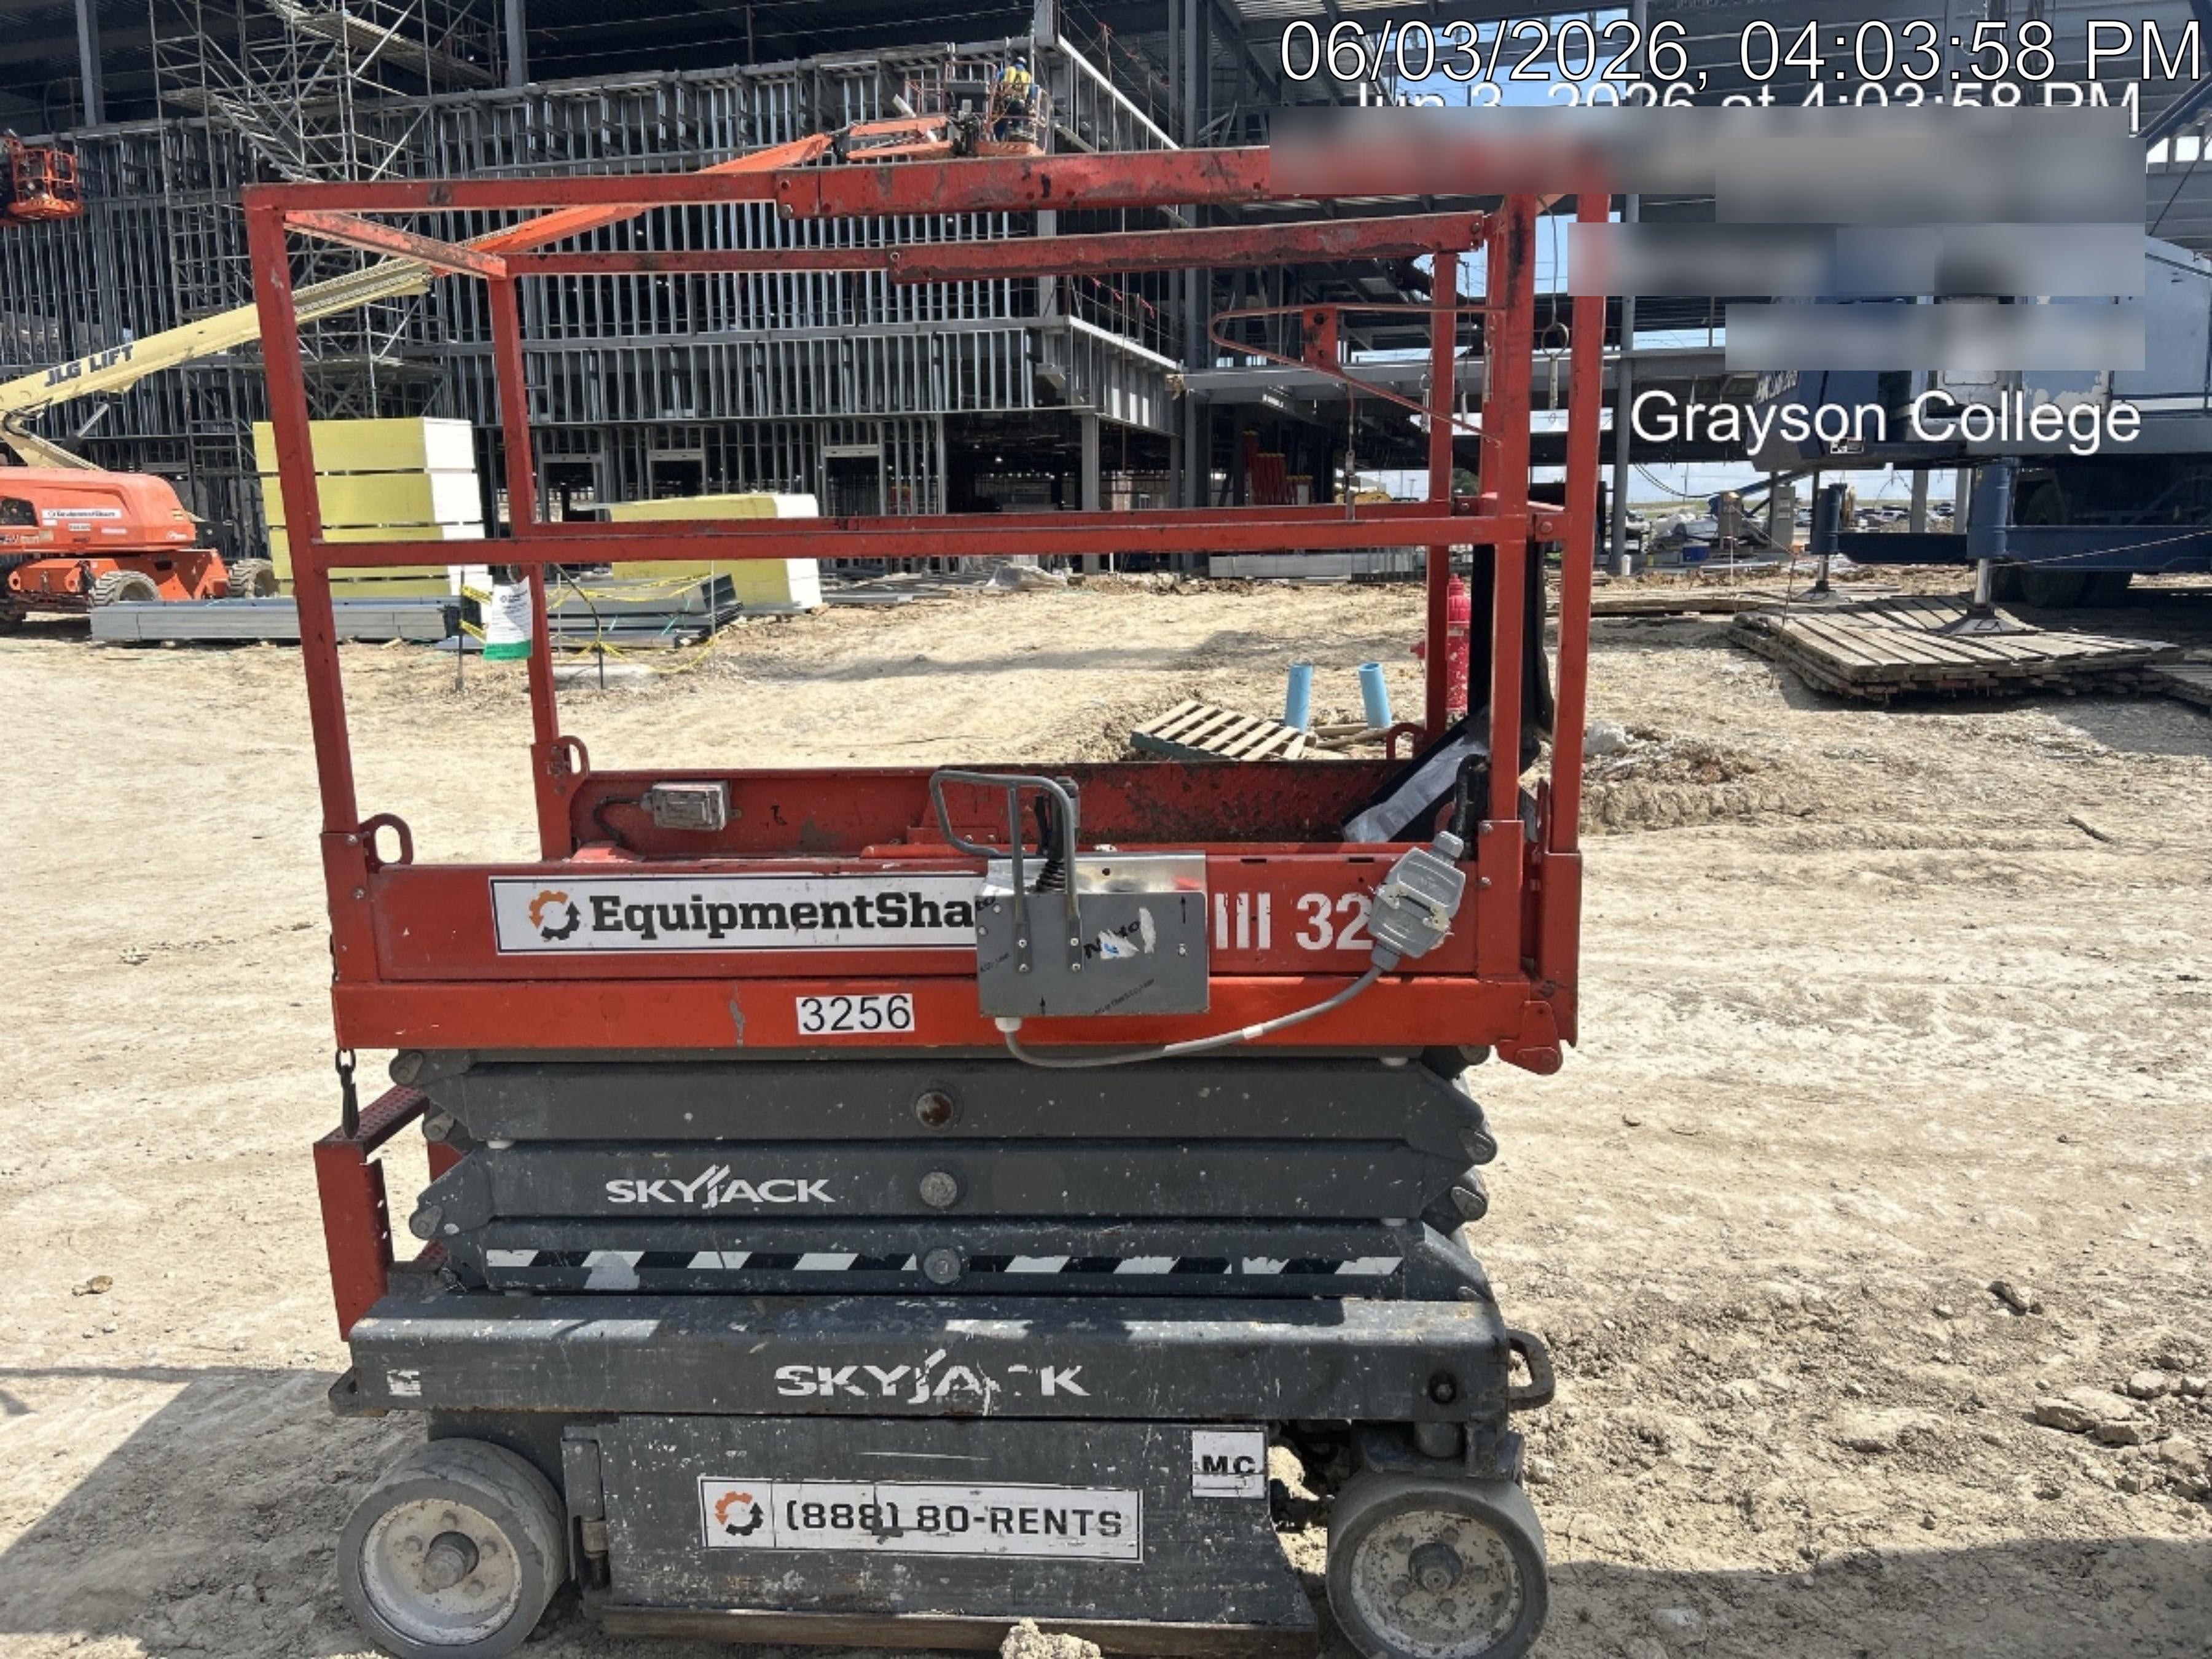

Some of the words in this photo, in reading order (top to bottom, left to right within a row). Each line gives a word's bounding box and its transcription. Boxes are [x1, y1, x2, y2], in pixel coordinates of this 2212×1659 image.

[44, 361, 81, 387] JLG
[88, 344, 134, 373] LIFT
[801, 995, 911, 1032] 3256
[606, 1164, 836, 1210] SKYJACK
[785, 1500, 900, 1533] (888)
[916, 1505, 1123, 1537] 80-RENTS
